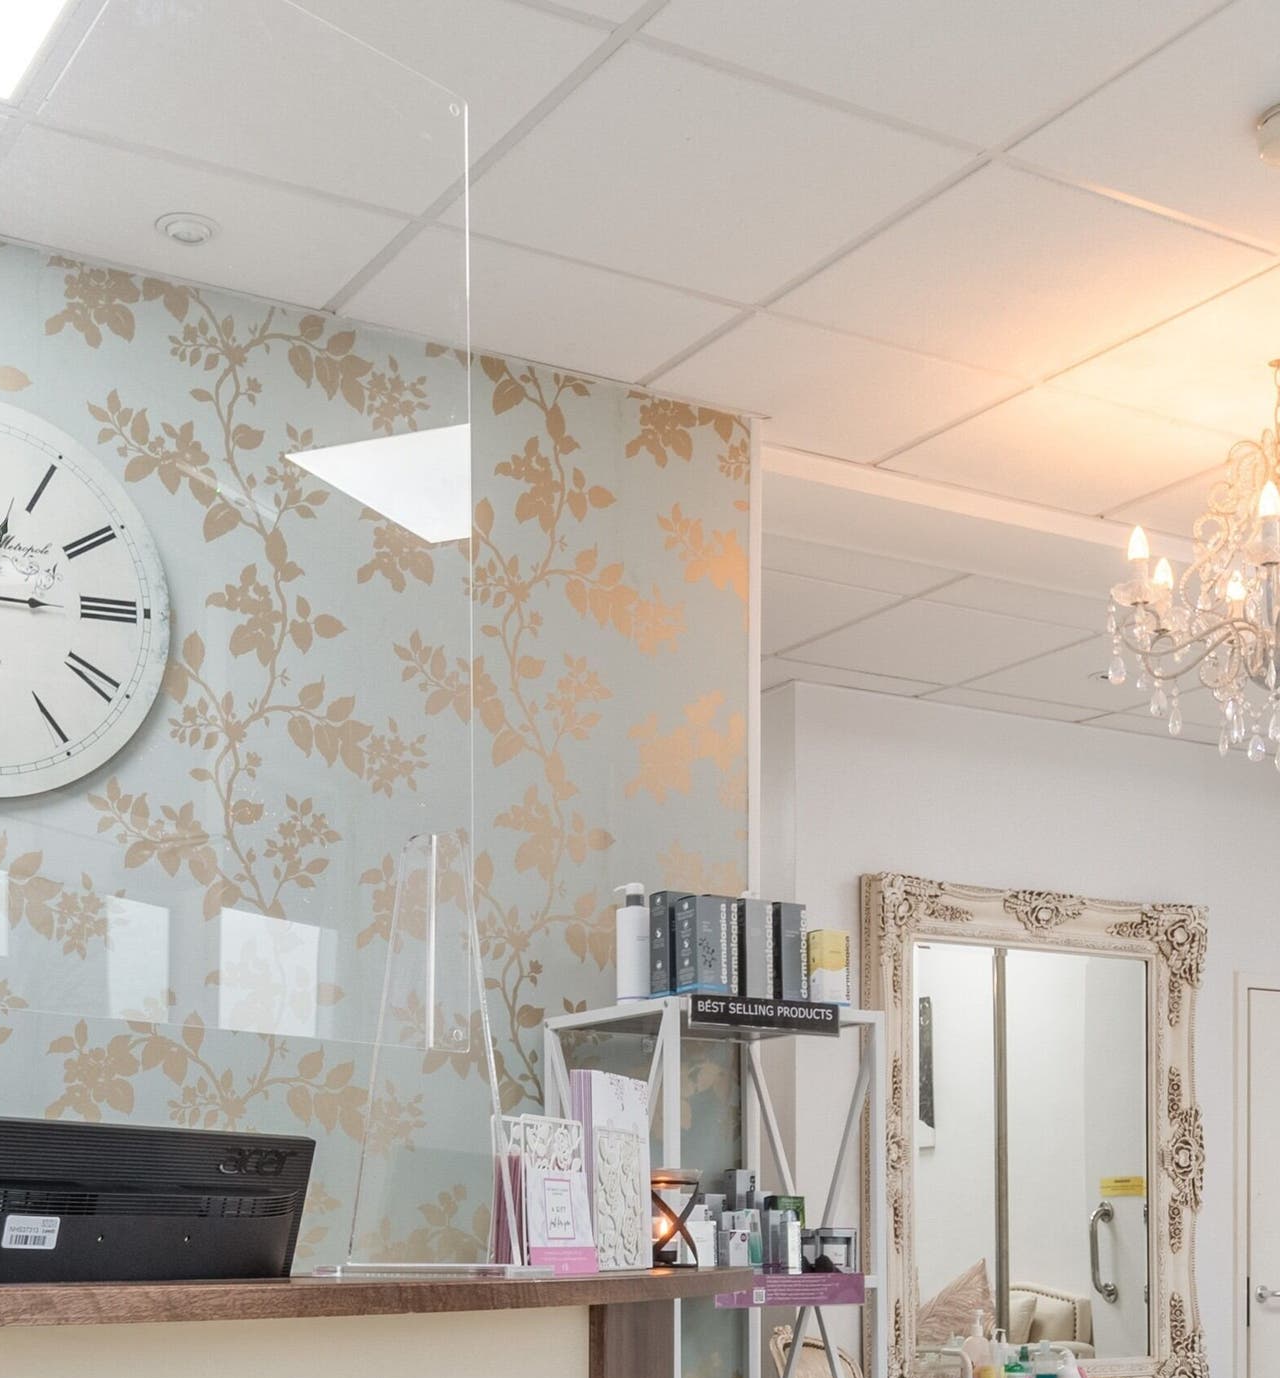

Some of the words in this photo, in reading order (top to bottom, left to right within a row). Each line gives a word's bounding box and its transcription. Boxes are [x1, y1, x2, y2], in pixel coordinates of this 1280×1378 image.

[730, 902, 738, 994] dermalogica
[800, 910, 808, 999] dermalogica
[697, 999, 726, 1014] BEST
[728, 1002, 774, 1017] SELLING
[777, 1005, 833, 1020] PRODUCTS
[219, 1147, 295, 1174] acer
